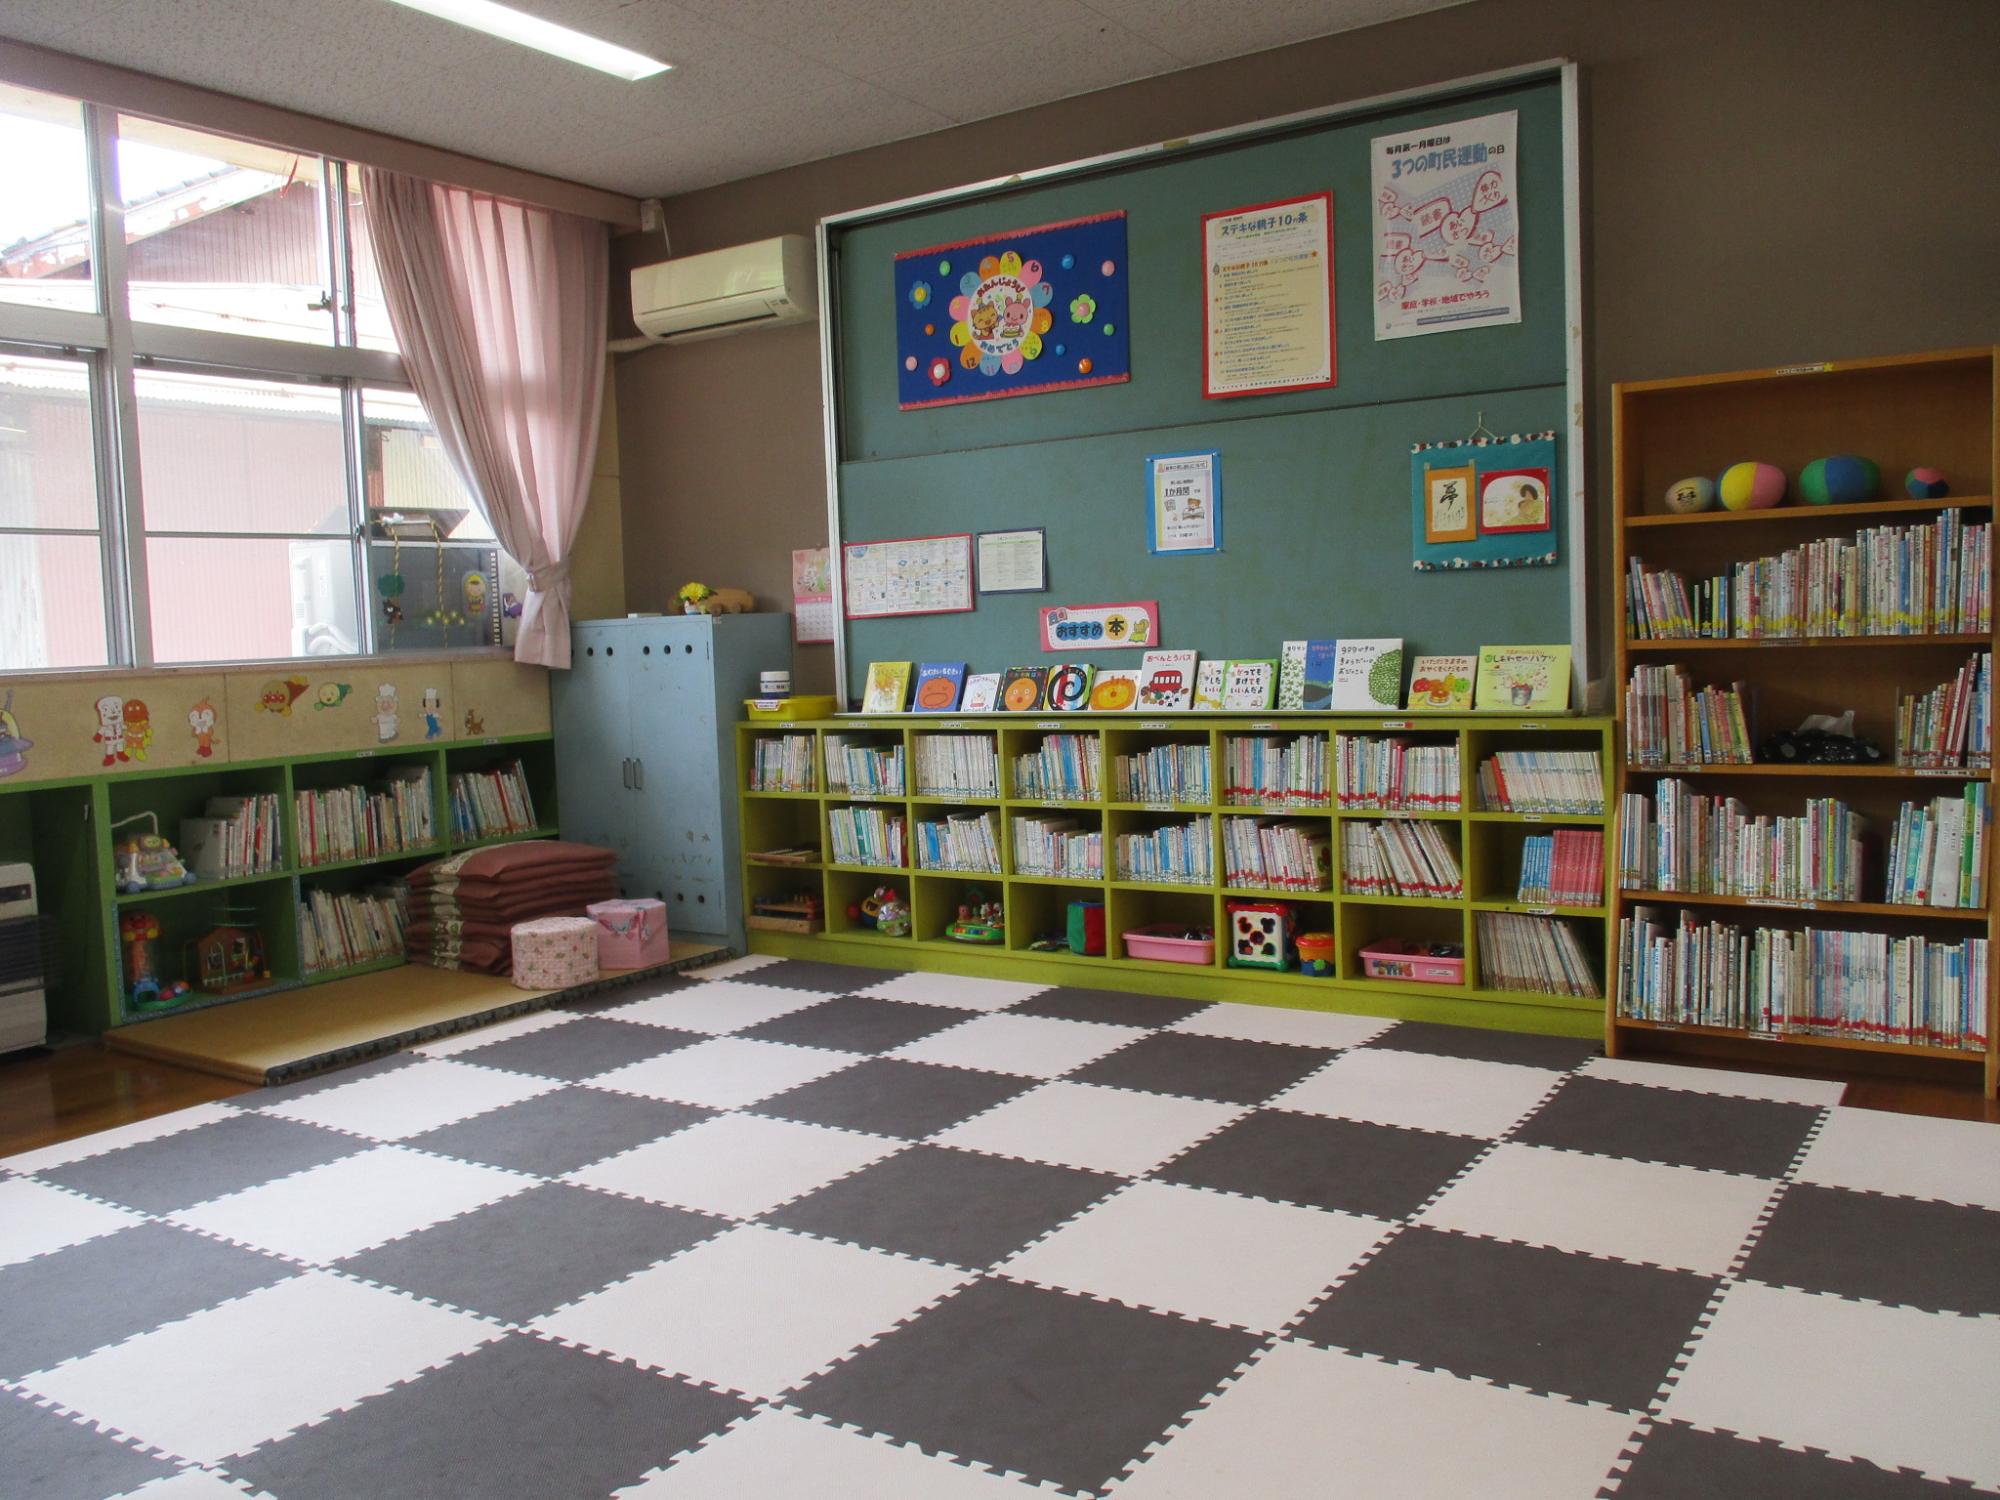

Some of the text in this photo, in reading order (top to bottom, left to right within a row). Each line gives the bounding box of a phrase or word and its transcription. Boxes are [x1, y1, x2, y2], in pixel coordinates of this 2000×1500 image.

[1386, 136, 1451, 155] 毎月第一月曜日は
[1006, 252, 1015, 263] 5
[1030, 263, 1039, 272] 6
[1042, 285, 1050, 295] 7
[954, 334, 960, 345] 1
[980, 339, 1019, 353] おめでとう
[1030, 348, 1038, 358] 9
[966, 357, 976, 369] 12
[1056, 618, 1125, 638] おすすめ 本
[1146, 653, 1192, 663] おべんとうバス
[1493, 654, 1559, 663] しあわせのバケツ
[1235, 677, 1261, 685] まけても
[1230, 686, 1264, 694] いいんだよ
